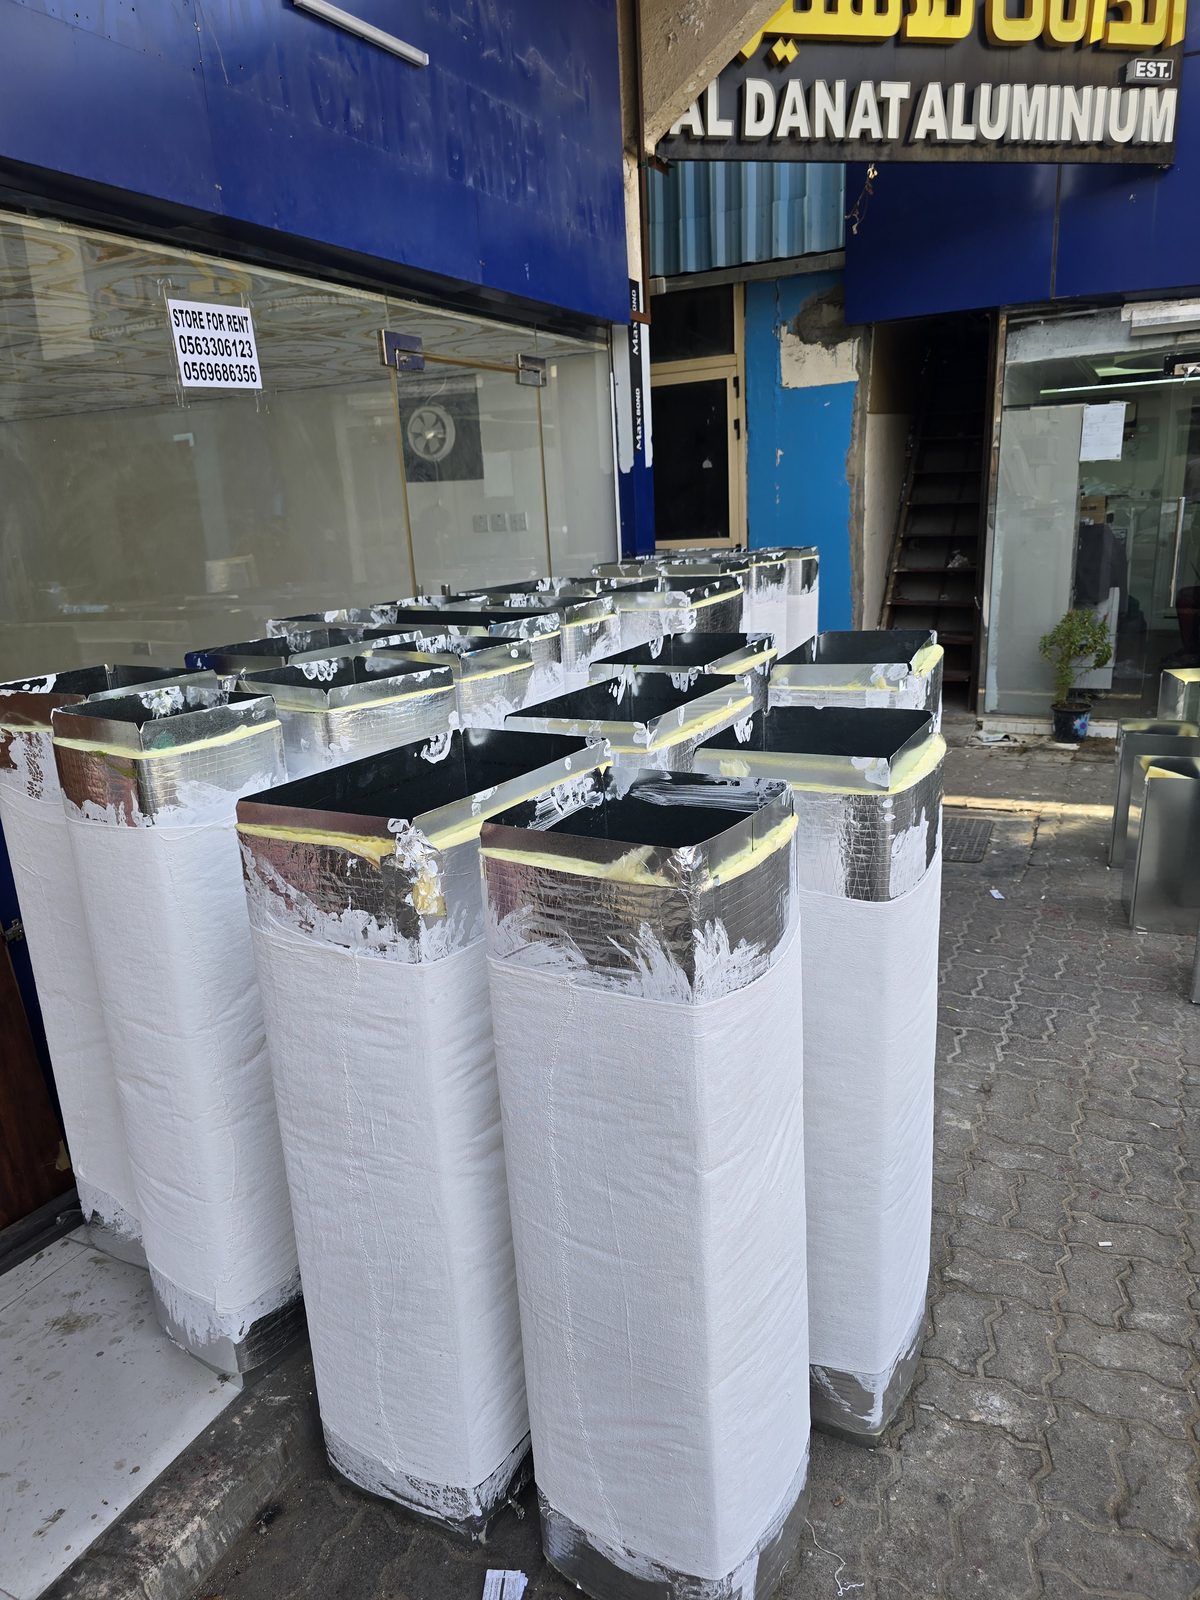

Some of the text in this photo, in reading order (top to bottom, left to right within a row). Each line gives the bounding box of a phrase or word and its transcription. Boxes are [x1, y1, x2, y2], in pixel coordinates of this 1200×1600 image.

[1135, 61, 1170, 78] EST.
[669, 76, 1177, 143] AL DANAT ALUMINIUM
[172, 308, 205, 330] STORE
[206, 312, 226, 332] FOR
[226, 314, 249, 334] RENT
[178, 335, 253, 359] 0563306123
[183, 361, 257, 383] 0569686356
